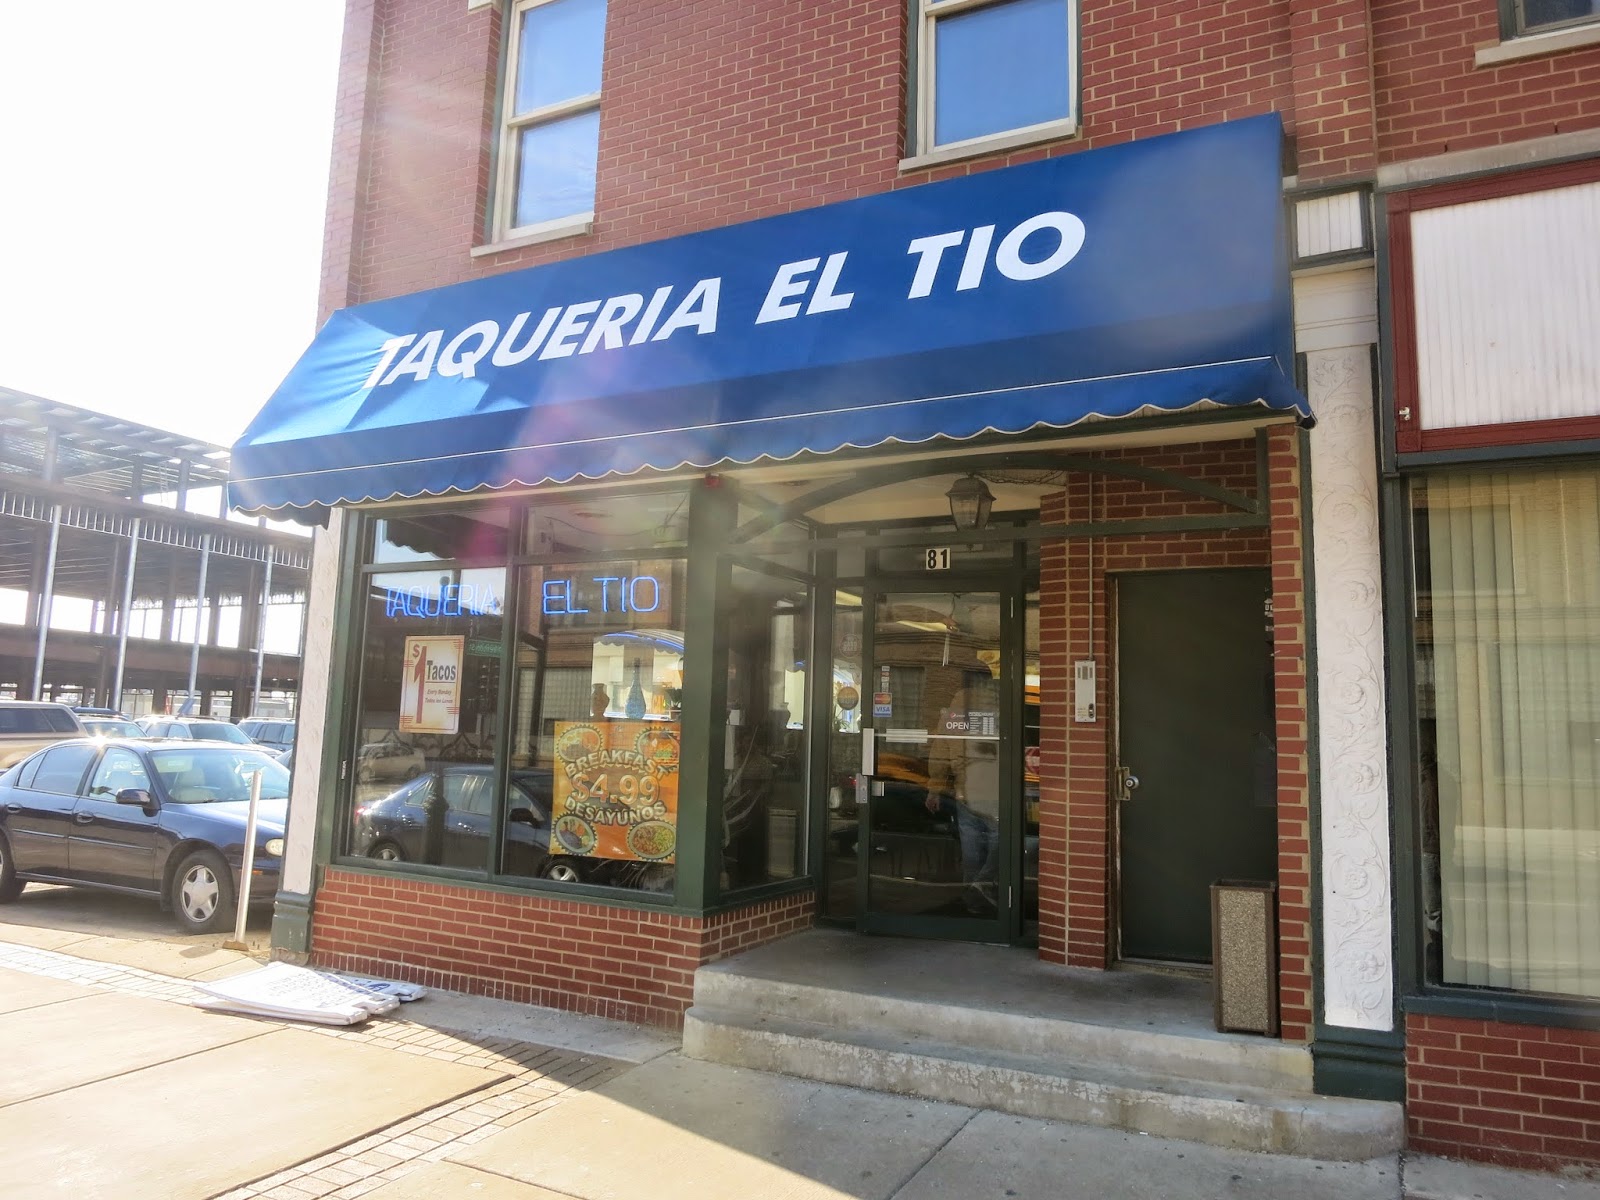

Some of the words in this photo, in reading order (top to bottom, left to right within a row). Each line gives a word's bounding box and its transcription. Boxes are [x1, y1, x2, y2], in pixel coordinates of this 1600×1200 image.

[364, 276, 721, 390] TAQUERIA
[755, 251, 854, 325] EL
[907, 210, 1087, 299] TIO
[927, 548, 948, 569] 81
[383, 584, 498, 618] TAQUERIA
[542, 579, 589, 614] EL
[593, 575, 660, 613] TIO
[426, 660, 456, 681] Tacos
[946, 721, 970, 730] OPEN
[565, 748, 670, 781] BREAKFAST
[570, 773, 660, 807] $4.99
[564, 796, 668, 826] DESAYUNOS
